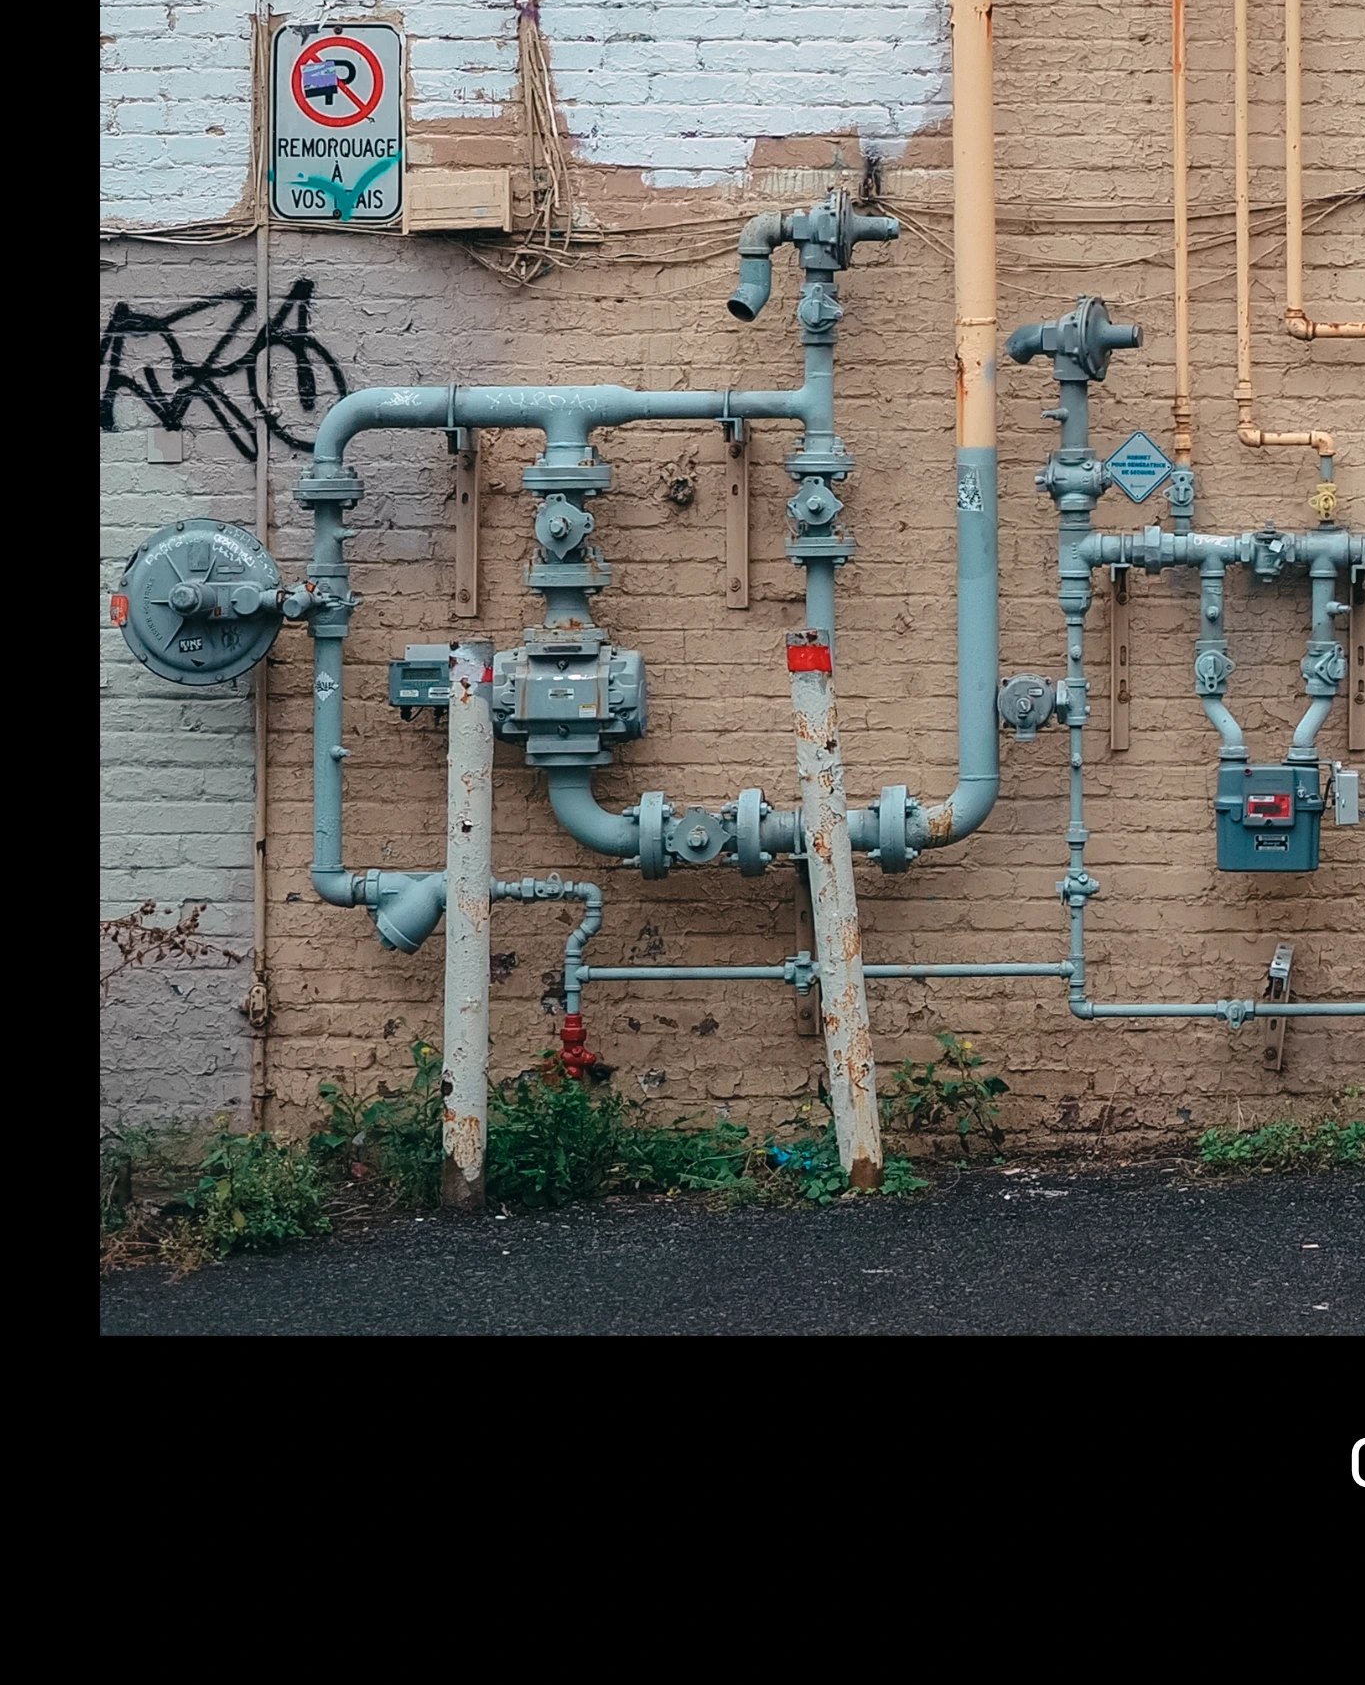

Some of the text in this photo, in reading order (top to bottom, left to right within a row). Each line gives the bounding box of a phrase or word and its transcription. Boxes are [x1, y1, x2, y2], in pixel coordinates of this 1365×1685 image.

[278, 137, 397, 158] REMORQUAGE
[331, 161, 343, 183] À
[291, 189, 326, 209] VOS
